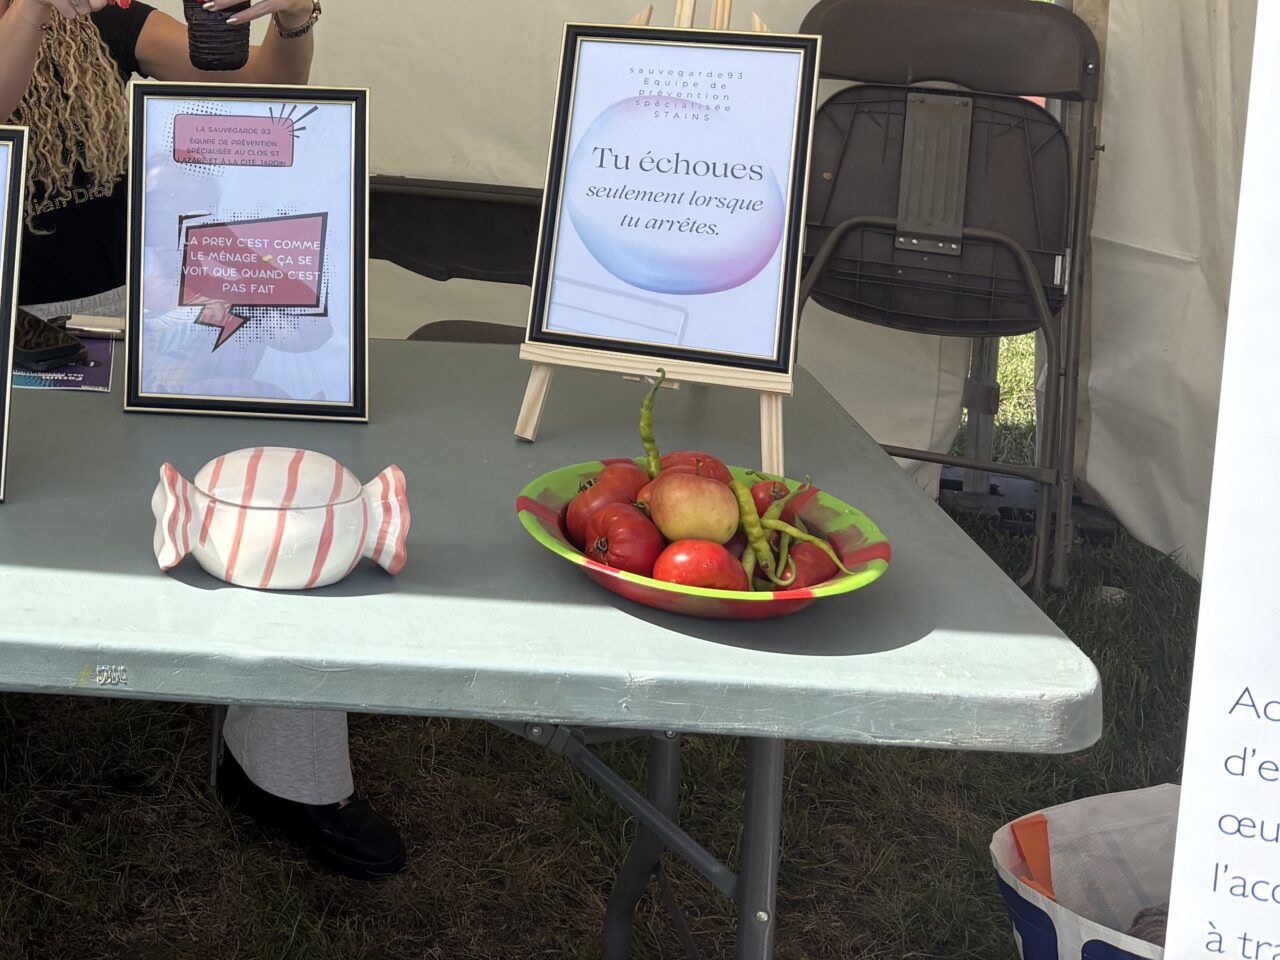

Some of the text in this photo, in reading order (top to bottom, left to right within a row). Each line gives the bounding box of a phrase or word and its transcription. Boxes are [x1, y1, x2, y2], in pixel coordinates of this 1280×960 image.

[629, 66, 744, 80] sauvegarde93
[643, 77, 727, 90] Equipe de
[638, 88, 730, 101] prévention
[634, 98, 731, 112] spécialisée
[208, 126, 258, 135] SAUVEGARDE
[231, 138, 277, 147] PRÉVENTION
[186, 146, 232, 156] SPÉCIALISÉE
[247, 149, 267, 157] CLOS
[591, 146, 764, 181] Tu échoues
[585, 184, 764, 214] seulement lorsque
[619, 213, 720, 236] tu arrêtes.
[202, 237, 233, 247] PREV
[236, 238, 270, 249] C'EST
[273, 239, 321, 251] COMME
[190, 250, 313, 267] LE MÉNAGE ÇA SE
[182, 266, 322, 281] VOIT QUE QUAND C'EST
[222, 282, 276, 295] PAS FAIT
[1223, 746, 1280, 782] d'e
[1205, 920, 1225, 955] à
